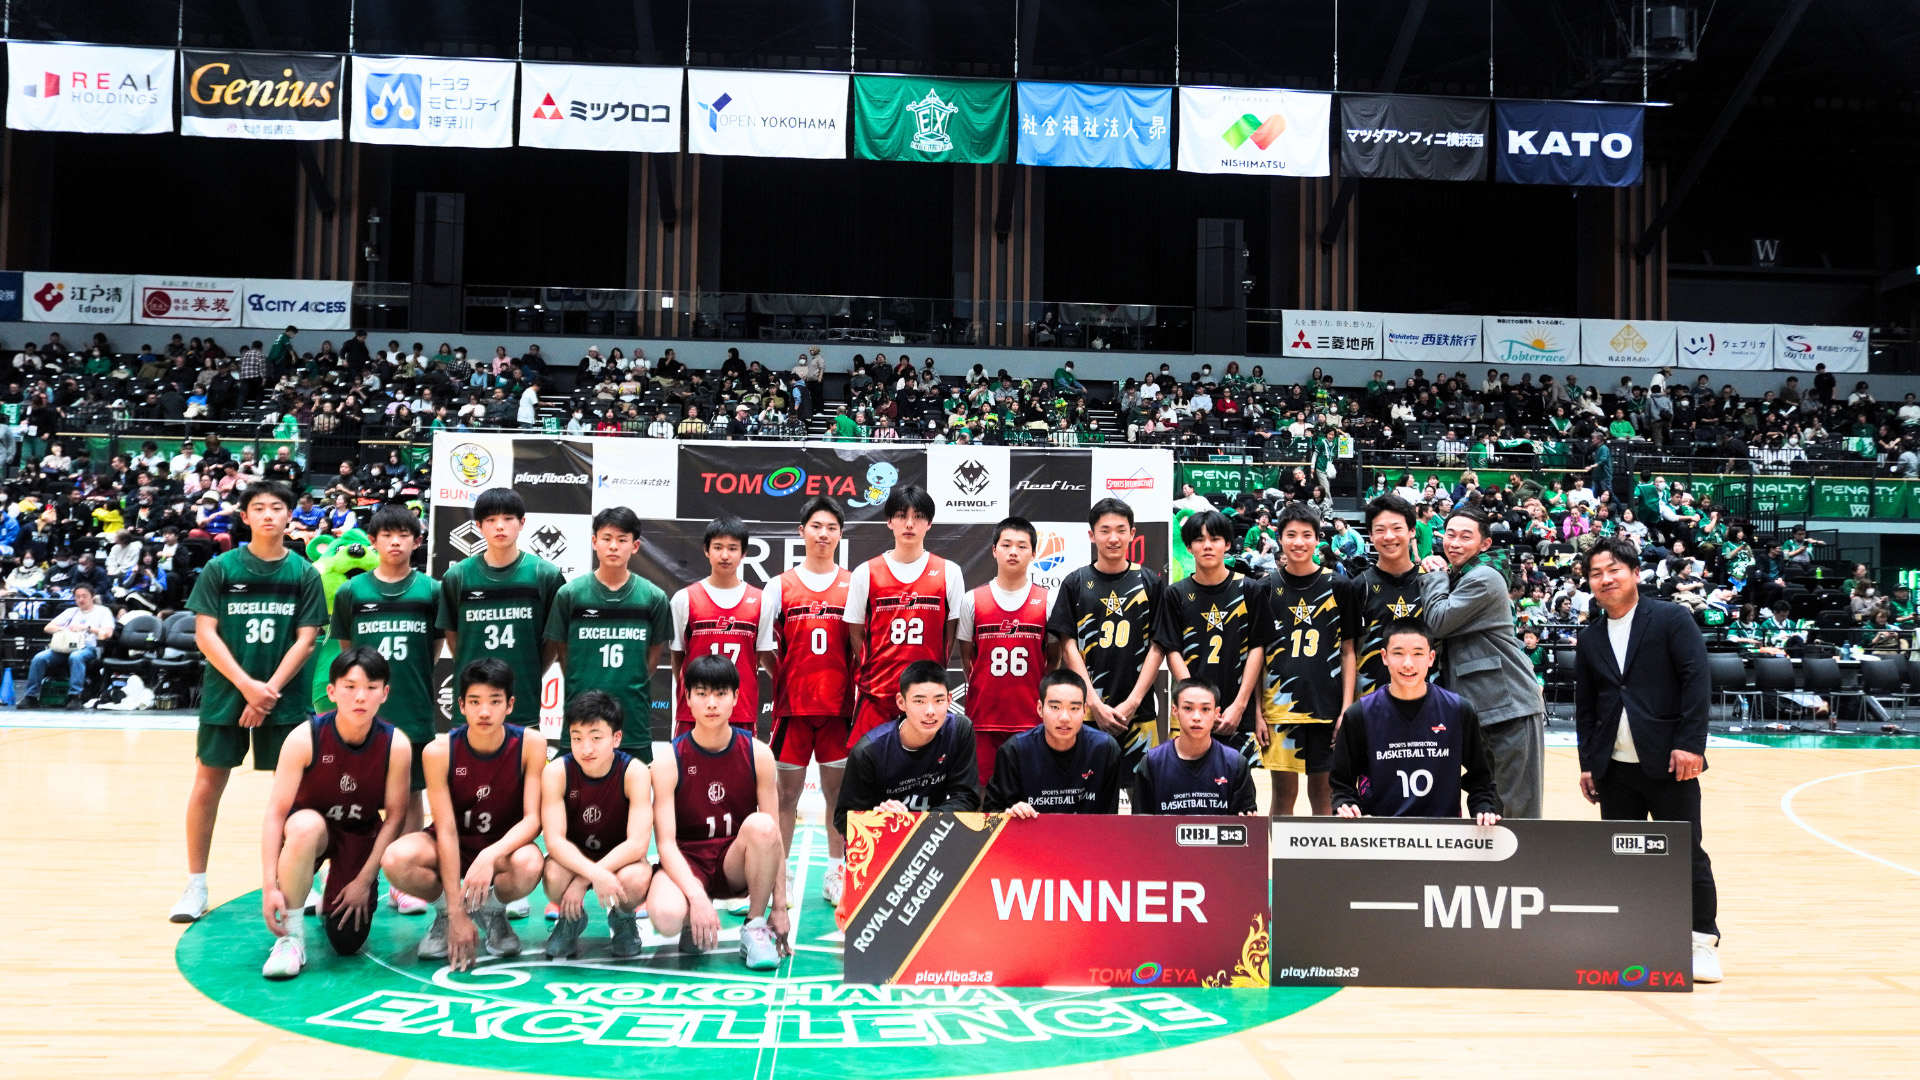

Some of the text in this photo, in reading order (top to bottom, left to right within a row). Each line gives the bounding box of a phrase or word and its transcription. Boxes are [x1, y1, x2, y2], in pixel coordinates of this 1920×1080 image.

[72, 72, 157, 91] REAL
[189, 62, 334, 108] Genius
[429, 77, 469, 91] トヨタ
[71, 92, 158, 104] HOLDINGS
[428, 96, 500, 112] モビリティ
[570, 100, 670, 122] ミツウロコ
[428, 115, 473, 130] 神奈川
[719, 115, 836, 130] OPEN YOKOHAMA
[1346, 129, 1484, 148] マツダアンフィニ横浜西
[1508, 130, 1633, 159] KATO
[1221, 159, 1286, 169] NISHIMATSU
[1754, 239, 1779, 261] W
[191, 297, 230, 312] 美装
[265, 300, 346, 313] CITY ACCESS
[1316, 336, 1374, 350] 三菱地所
[1421, 333, 1477, 346] 西鉄旅行
[1722, 340, 1766, 349] ウェブリカ
[1499, 340, 1565, 362] Jobterrace
[514, 472, 589, 485] play.fiba3x3
[611, 477, 671, 487] 共和ゴム株式会社
[227, 602, 296, 616] EXCELLENCE
[466, 607, 533, 621] EXCELLENCE
[245, 618, 276, 644] 36
[357, 620, 427, 634] EXCELLENCE
[578, 627, 646, 641] EXCELLENCE
[890, 617, 924, 645] 82
[1099, 620, 1130, 649] 30
[484, 624, 515, 650] 34
[811, 628, 827, 655] 0
[1290, 628, 1320, 658] 13
[377, 636, 408, 661] 45
[599, 644, 624, 668] 16
[709, 642, 741, 665] 17
[1207, 634, 1223, 664] 2
[990, 646, 1029, 676] 86
[1376, 748, 1449, 760] BASKETBALL TEAM
[1396, 768, 1434, 798] 10
[1028, 794, 1075, 807] BASKETBALL
[1161, 799, 1208, 811] BASKETBALL
[464, 810, 492, 834] 13
[706, 813, 732, 838] 11
[585, 834, 601, 851] 6
[1180, 828, 1243, 841] RBL 3x3
[1289, 836, 1494, 849] ROYAL BASKETBALL LEAGUE
[1616, 837, 1665, 850] RBL 3x3
[853, 819, 955, 953] ROYAL BASKETBALL
[898, 866, 944, 926] LEAGUE
[990, 878, 1209, 924] WINNER
[1424, 885, 1545, 930] MVP
[915, 969, 994, 985] play.fiba3x3
[1280, 966, 1360, 979] play.fiba3x3
[544, 982, 1020, 1006] YOKOHAMA
[306, 989, 1228, 1048] EXCELLENCE
